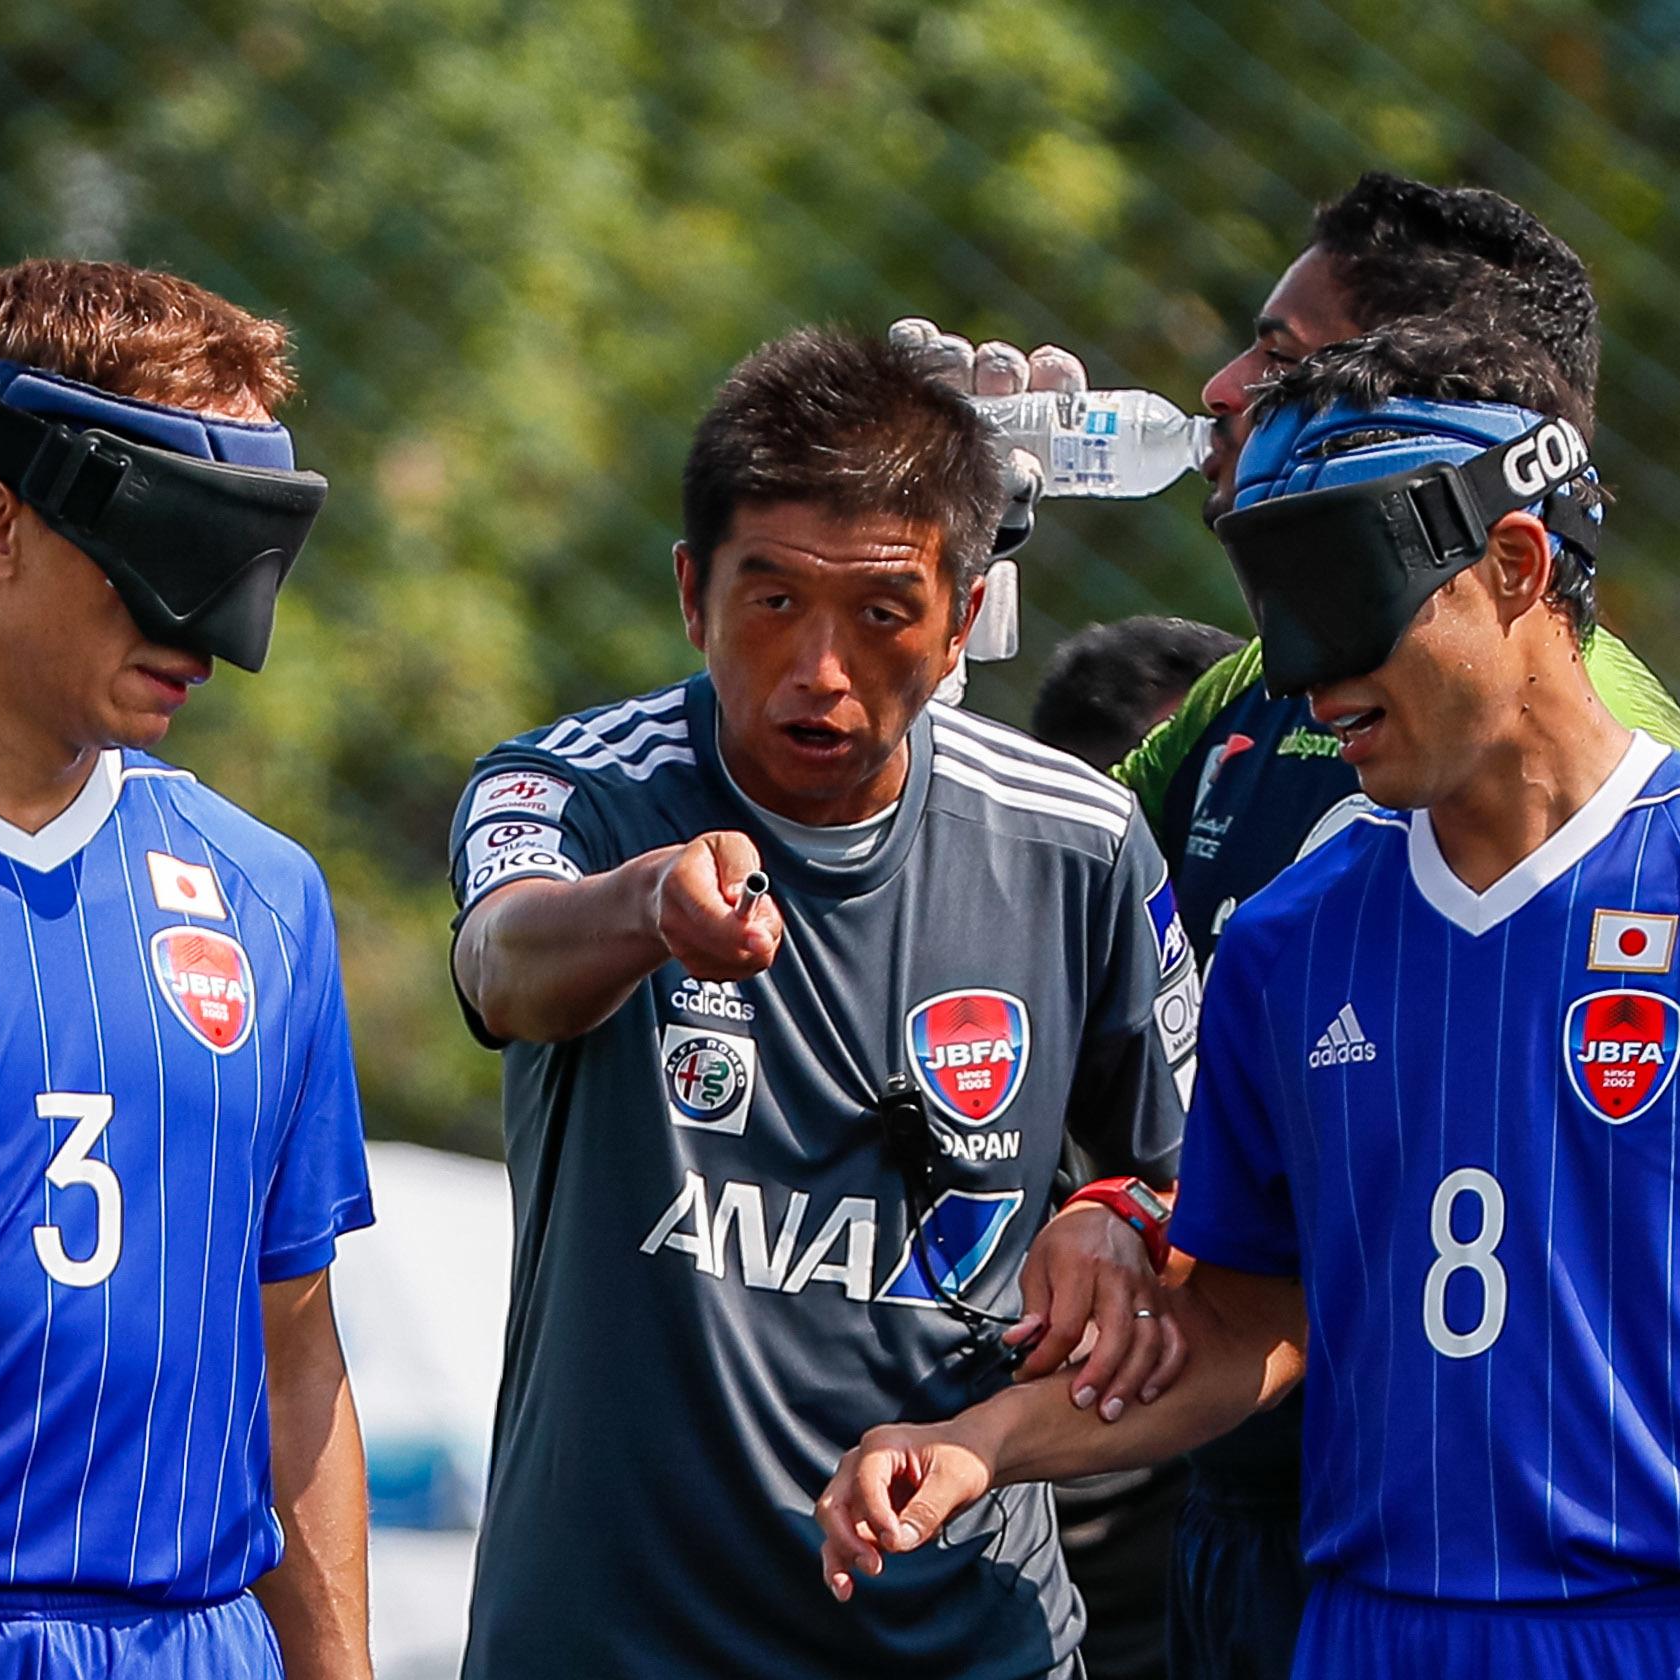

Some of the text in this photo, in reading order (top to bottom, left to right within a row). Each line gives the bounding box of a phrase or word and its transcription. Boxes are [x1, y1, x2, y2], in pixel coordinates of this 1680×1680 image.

[172, 971, 247, 1003] JBFA
[671, 990, 756, 1021] adidas
[667, 1039, 746, 1088] ALFA ROMEO
[925, 1039, 1016, 1070] JBFA
[1309, 1040, 1376, 1069] adidas
[1577, 1041, 1665, 1065] JBFA
[957, 1078, 992, 1091] 2002
[1602, 1078, 1636, 1088] 2002
[940, 1130, 1020, 1161] JAPAN
[31, 1090, 123, 1289] 3
[638, 1170, 878, 1303] ANA
[1422, 1166, 1508, 1359] 8
